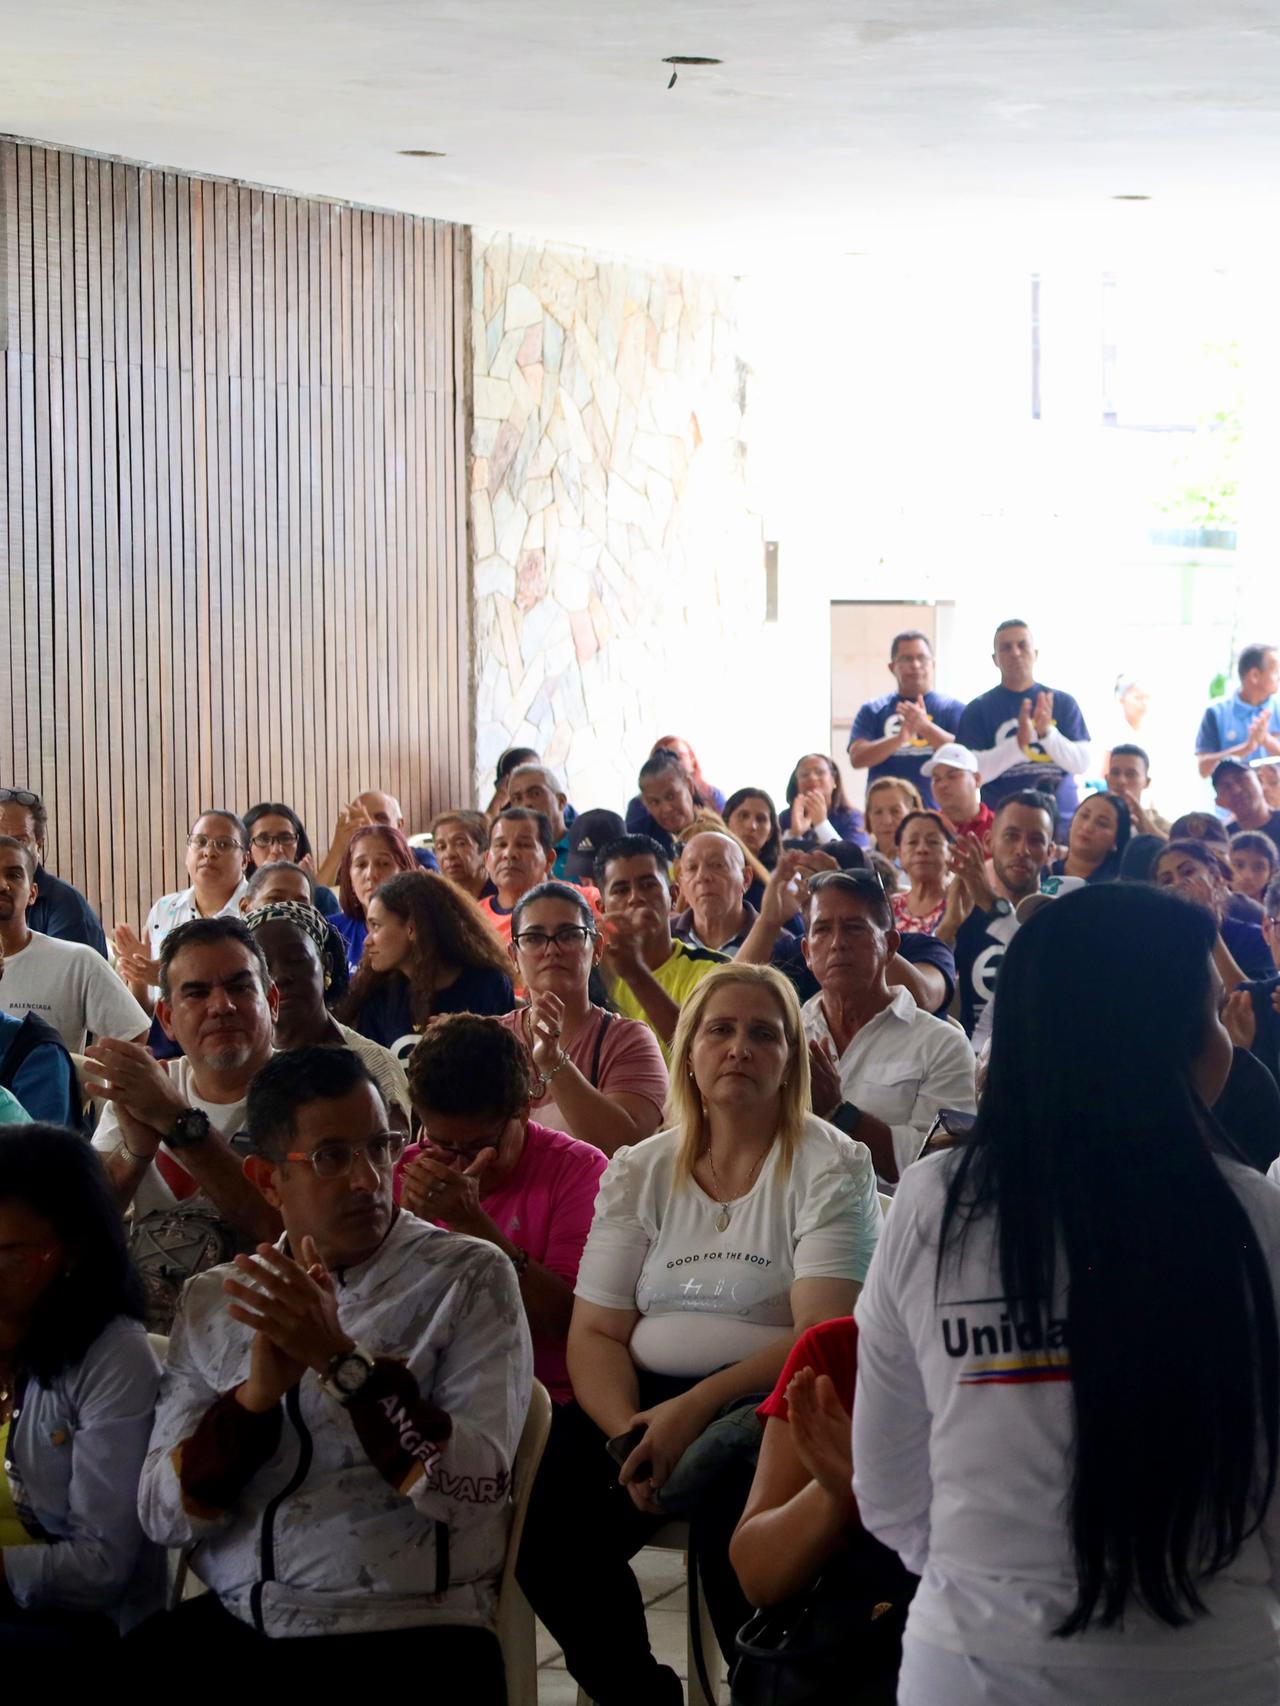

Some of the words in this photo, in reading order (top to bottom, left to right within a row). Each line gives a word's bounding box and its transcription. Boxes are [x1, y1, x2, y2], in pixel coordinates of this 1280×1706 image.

[666, 1254, 700, 1269] GOOD
[703, 1252, 723, 1260] FOR
[726, 1252, 741, 1260] THE
[744, 1253, 772, 1268] BODY
[942, 1313, 1069, 1358] Unida
